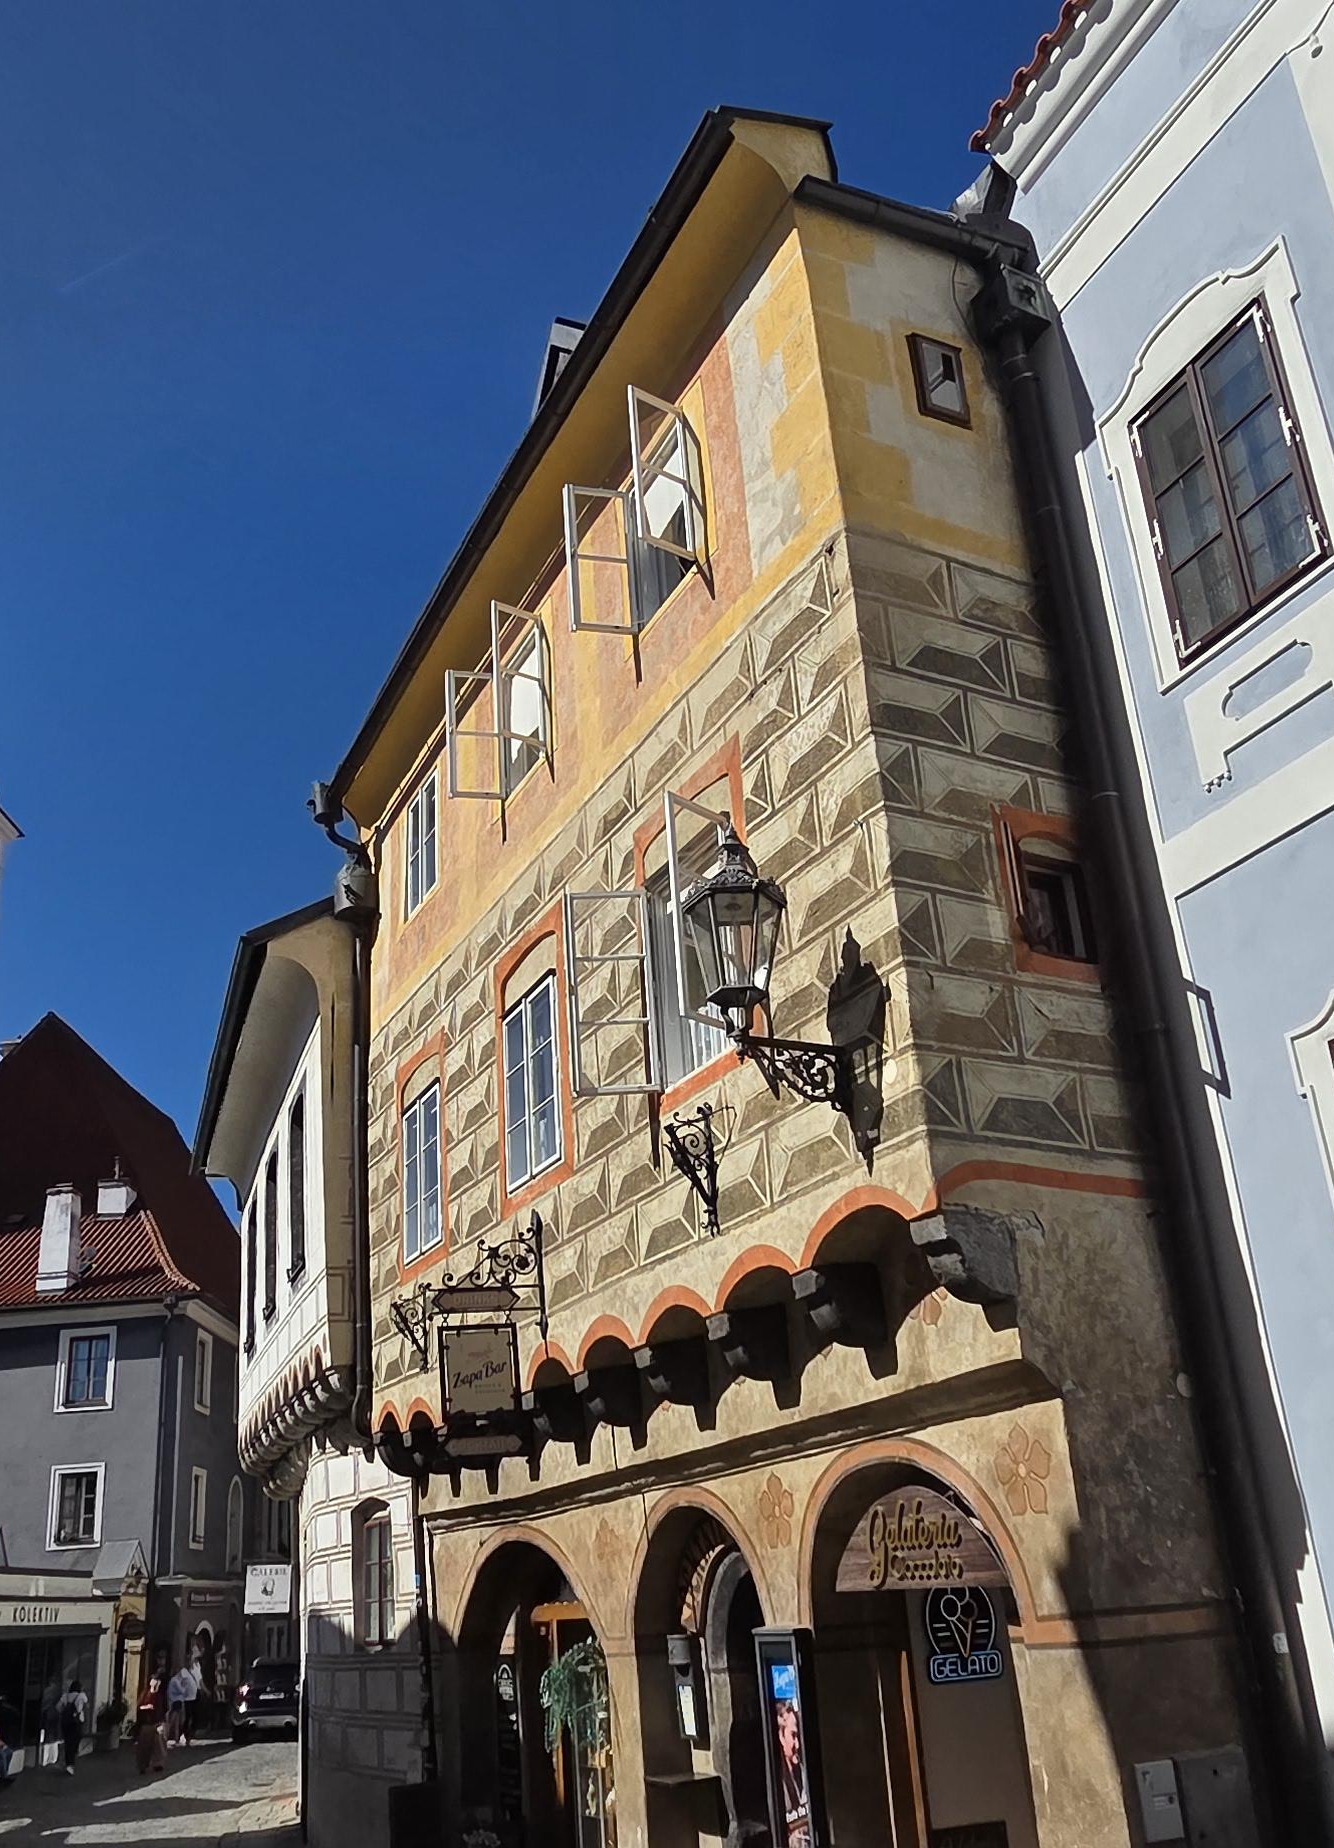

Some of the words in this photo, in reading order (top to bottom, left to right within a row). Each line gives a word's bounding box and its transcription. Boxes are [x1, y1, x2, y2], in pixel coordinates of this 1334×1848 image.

[453, 1371, 483, 1389] Zapa
[483, 1361, 507, 1378] Bar
[12, 1606, 60, 1623] KOLEKTIV
[935, 1655, 998, 1678] GELATO
